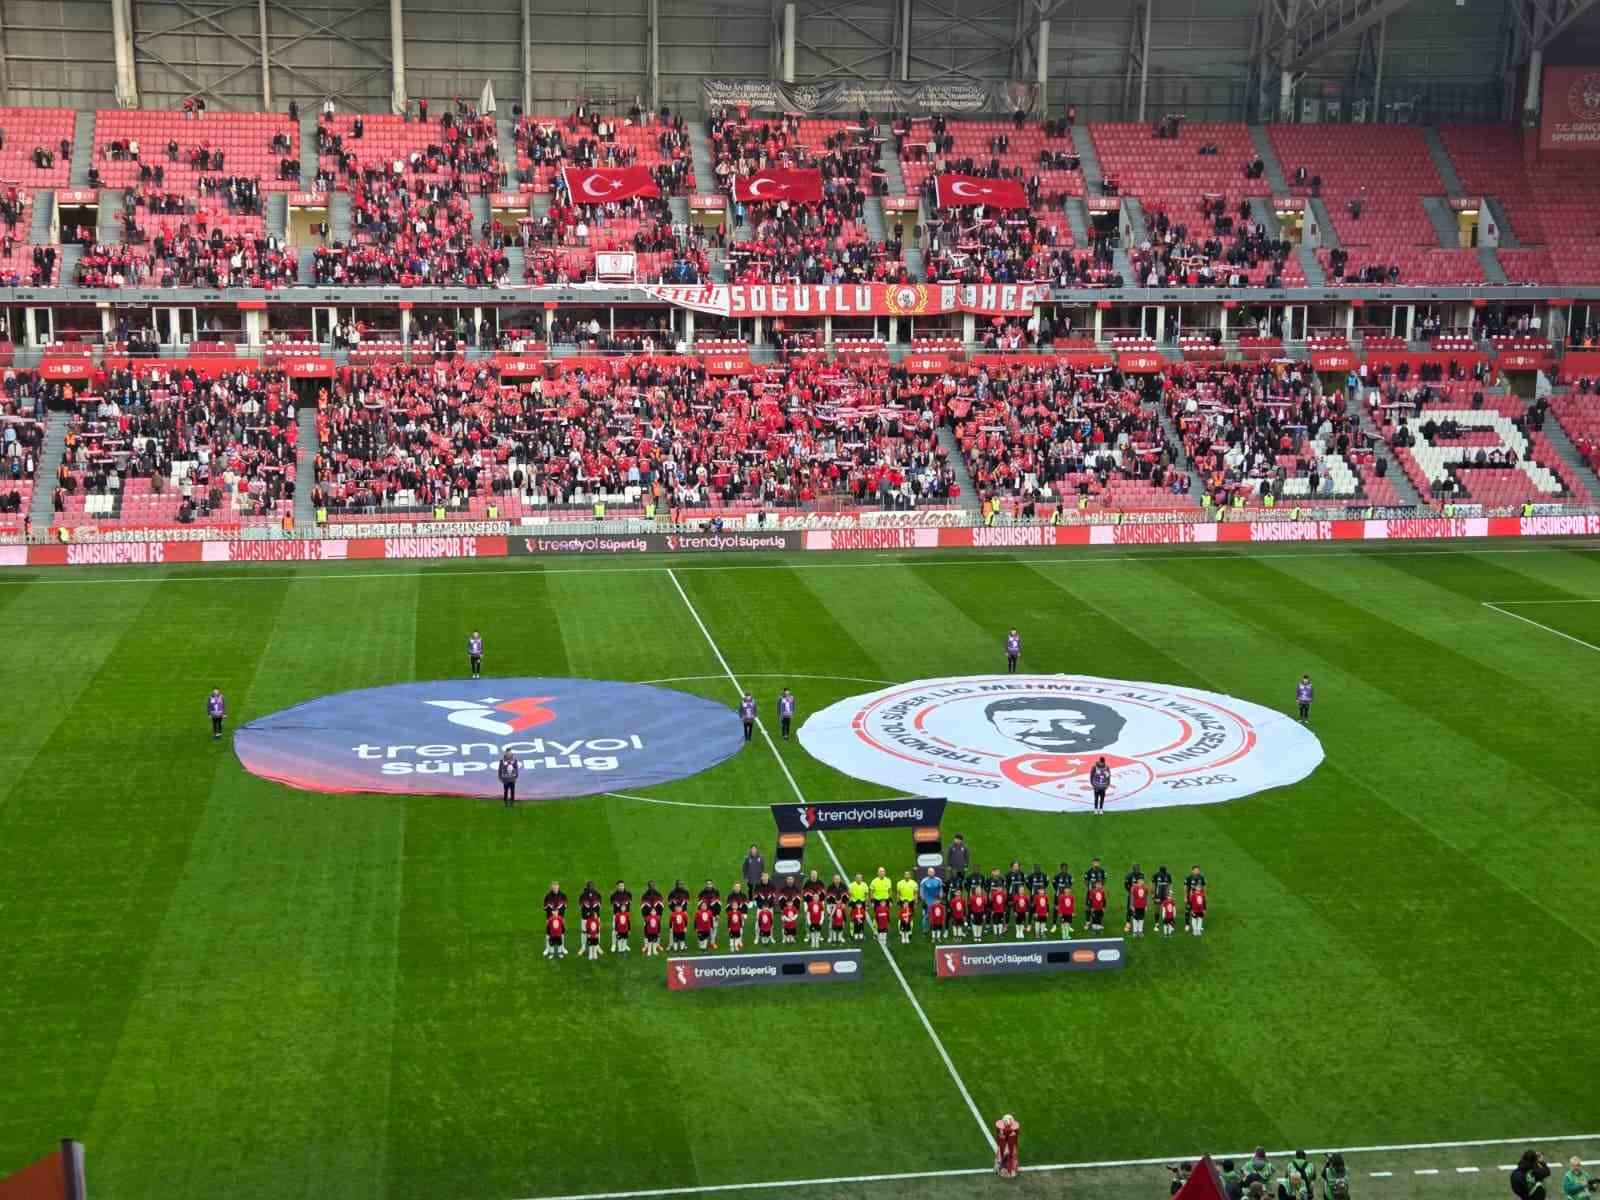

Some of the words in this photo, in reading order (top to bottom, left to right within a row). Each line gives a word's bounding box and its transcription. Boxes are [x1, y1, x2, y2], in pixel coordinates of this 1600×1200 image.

[1113, 524, 1179, 544] SAMSUNSPOR
[1182, 523, 1195, 542] FC
[1249, 521, 1316, 541] SAMSUNSPOR
[1319, 521, 1331, 539] FC
[1386, 518, 1451, 538] SAMSUNSPOR
[1453, 517, 1466, 537] FC
[1520, 516, 1585, 536] SAMSUNSPOR
[1587, 515, 1600, 535] FC
[680, 535, 738, 549] trendyol
[831, 528, 900, 549] SAMSUNSPOR
[903, 528, 916, 548] FC
[973, 526, 1041, 546] SAMSUNSPOR
[1043, 526, 1057, 545] FC
[67, 543, 146, 564] SAMSUNSPOR
[149, 542, 164, 562] FC
[228, 540, 304, 560] SAMSUNSPOR
[307, 540, 321, 560] FC
[384, 538, 459, 559] SAMSUNSPOR
[462, 537, 477, 557] FC
[880, 722, 982, 765] TRENDYOL
[979, 684, 1110, 694] MEHMET
[1157, 732, 1227, 765] SEZONU
[352, 734, 643, 760] trendyol
[921, 773, 1001, 790] 2025
[1162, 773, 1237, 790] 2026
[817, 807, 876, 823] trendyol
[961, 953, 1006, 966] trendyol
[694, 966, 741, 979] trendyol
